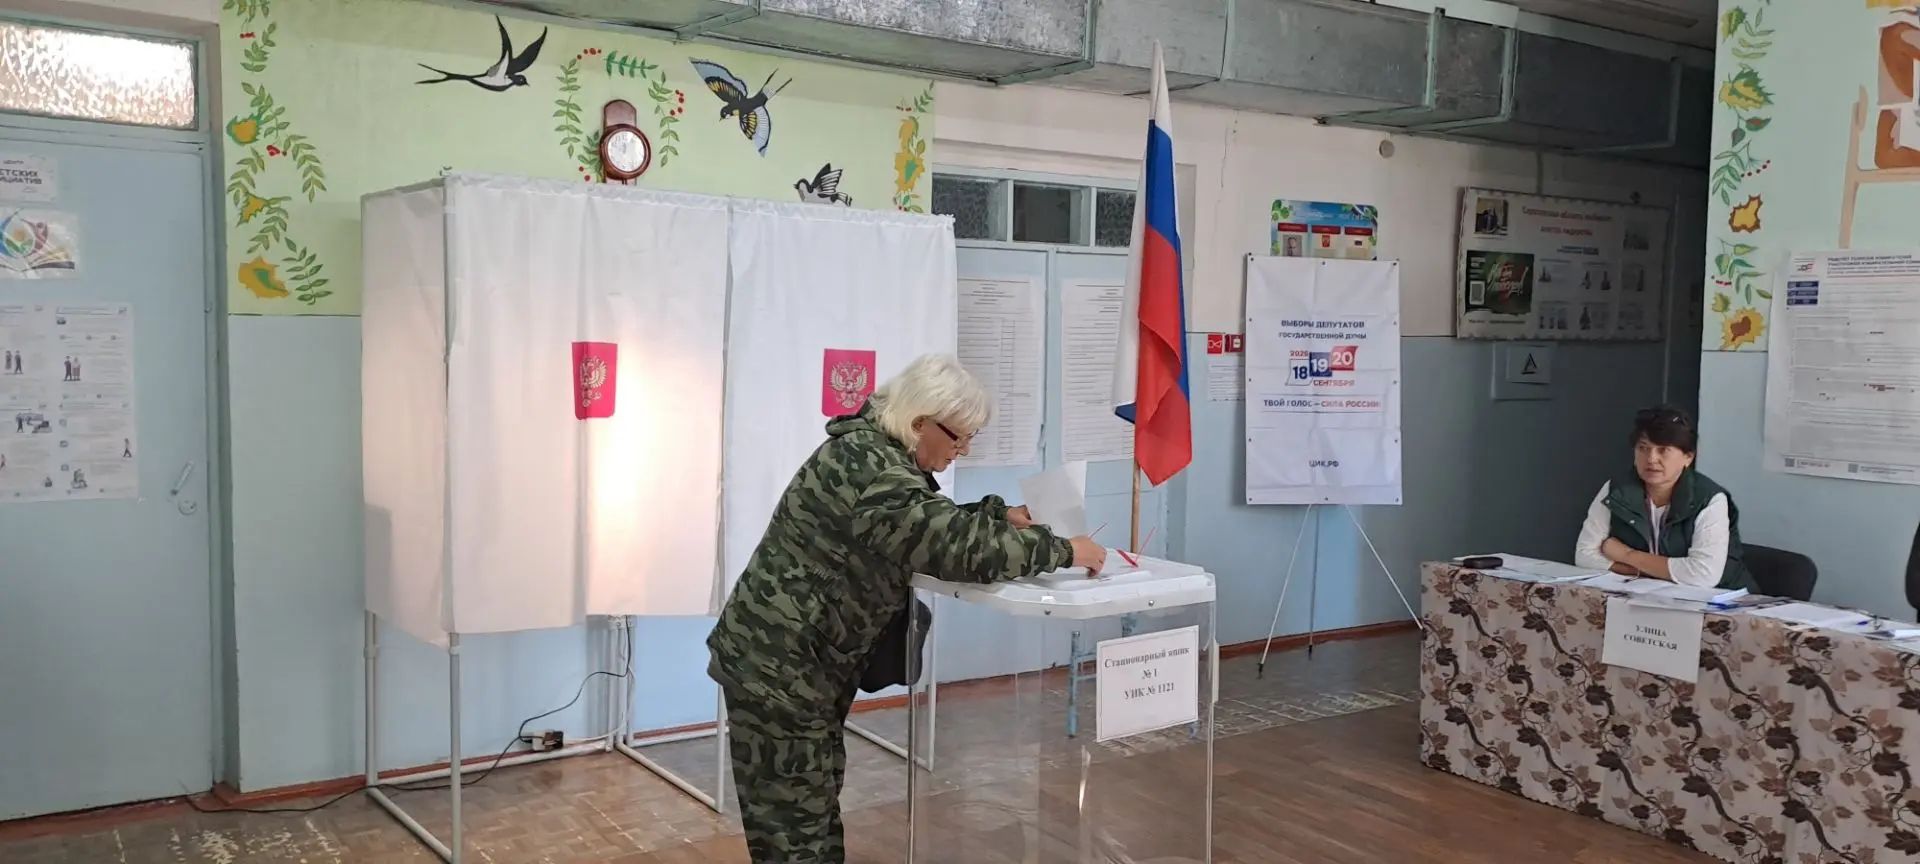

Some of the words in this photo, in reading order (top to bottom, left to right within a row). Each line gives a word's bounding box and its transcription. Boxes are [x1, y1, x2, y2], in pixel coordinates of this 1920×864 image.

[1281, 320, 1314, 328] ВЫБОРЫ
[1315, 321, 1365, 329] ДЕПУТАТОВ
[1278, 331, 1344, 339] ГОСУДАРСТВЕННОЙ
[1345, 332, 1367, 340] ДУМЫ
[1292, 366, 1308, 379] 18
[1311, 358, 1329, 373] 19
[1332, 351, 1353, 366] 20
[1313, 379, 1355, 387] СЕНТЯБРЯ
[1263, 398, 1285, 408] ТВОЙ
[1287, 399, 1313, 408] ГОЛОС
[1321, 400, 1344, 408] СИЛА
[1309, 460, 1340, 468] ЦИК.РФ
[1635, 625, 1667, 637] УЛИЦА
[1623, 634, 1678, 650] СОВЕТСКАЯ
[1104, 648, 1166, 668] Стационарный
[1168, 647, 1190, 657] ящик
[1142, 669, 1152, 680] №
[1124, 687, 1144, 699] УИК
[1146, 685, 1156, 696] №
[1157, 682, 1175, 695] 1121
